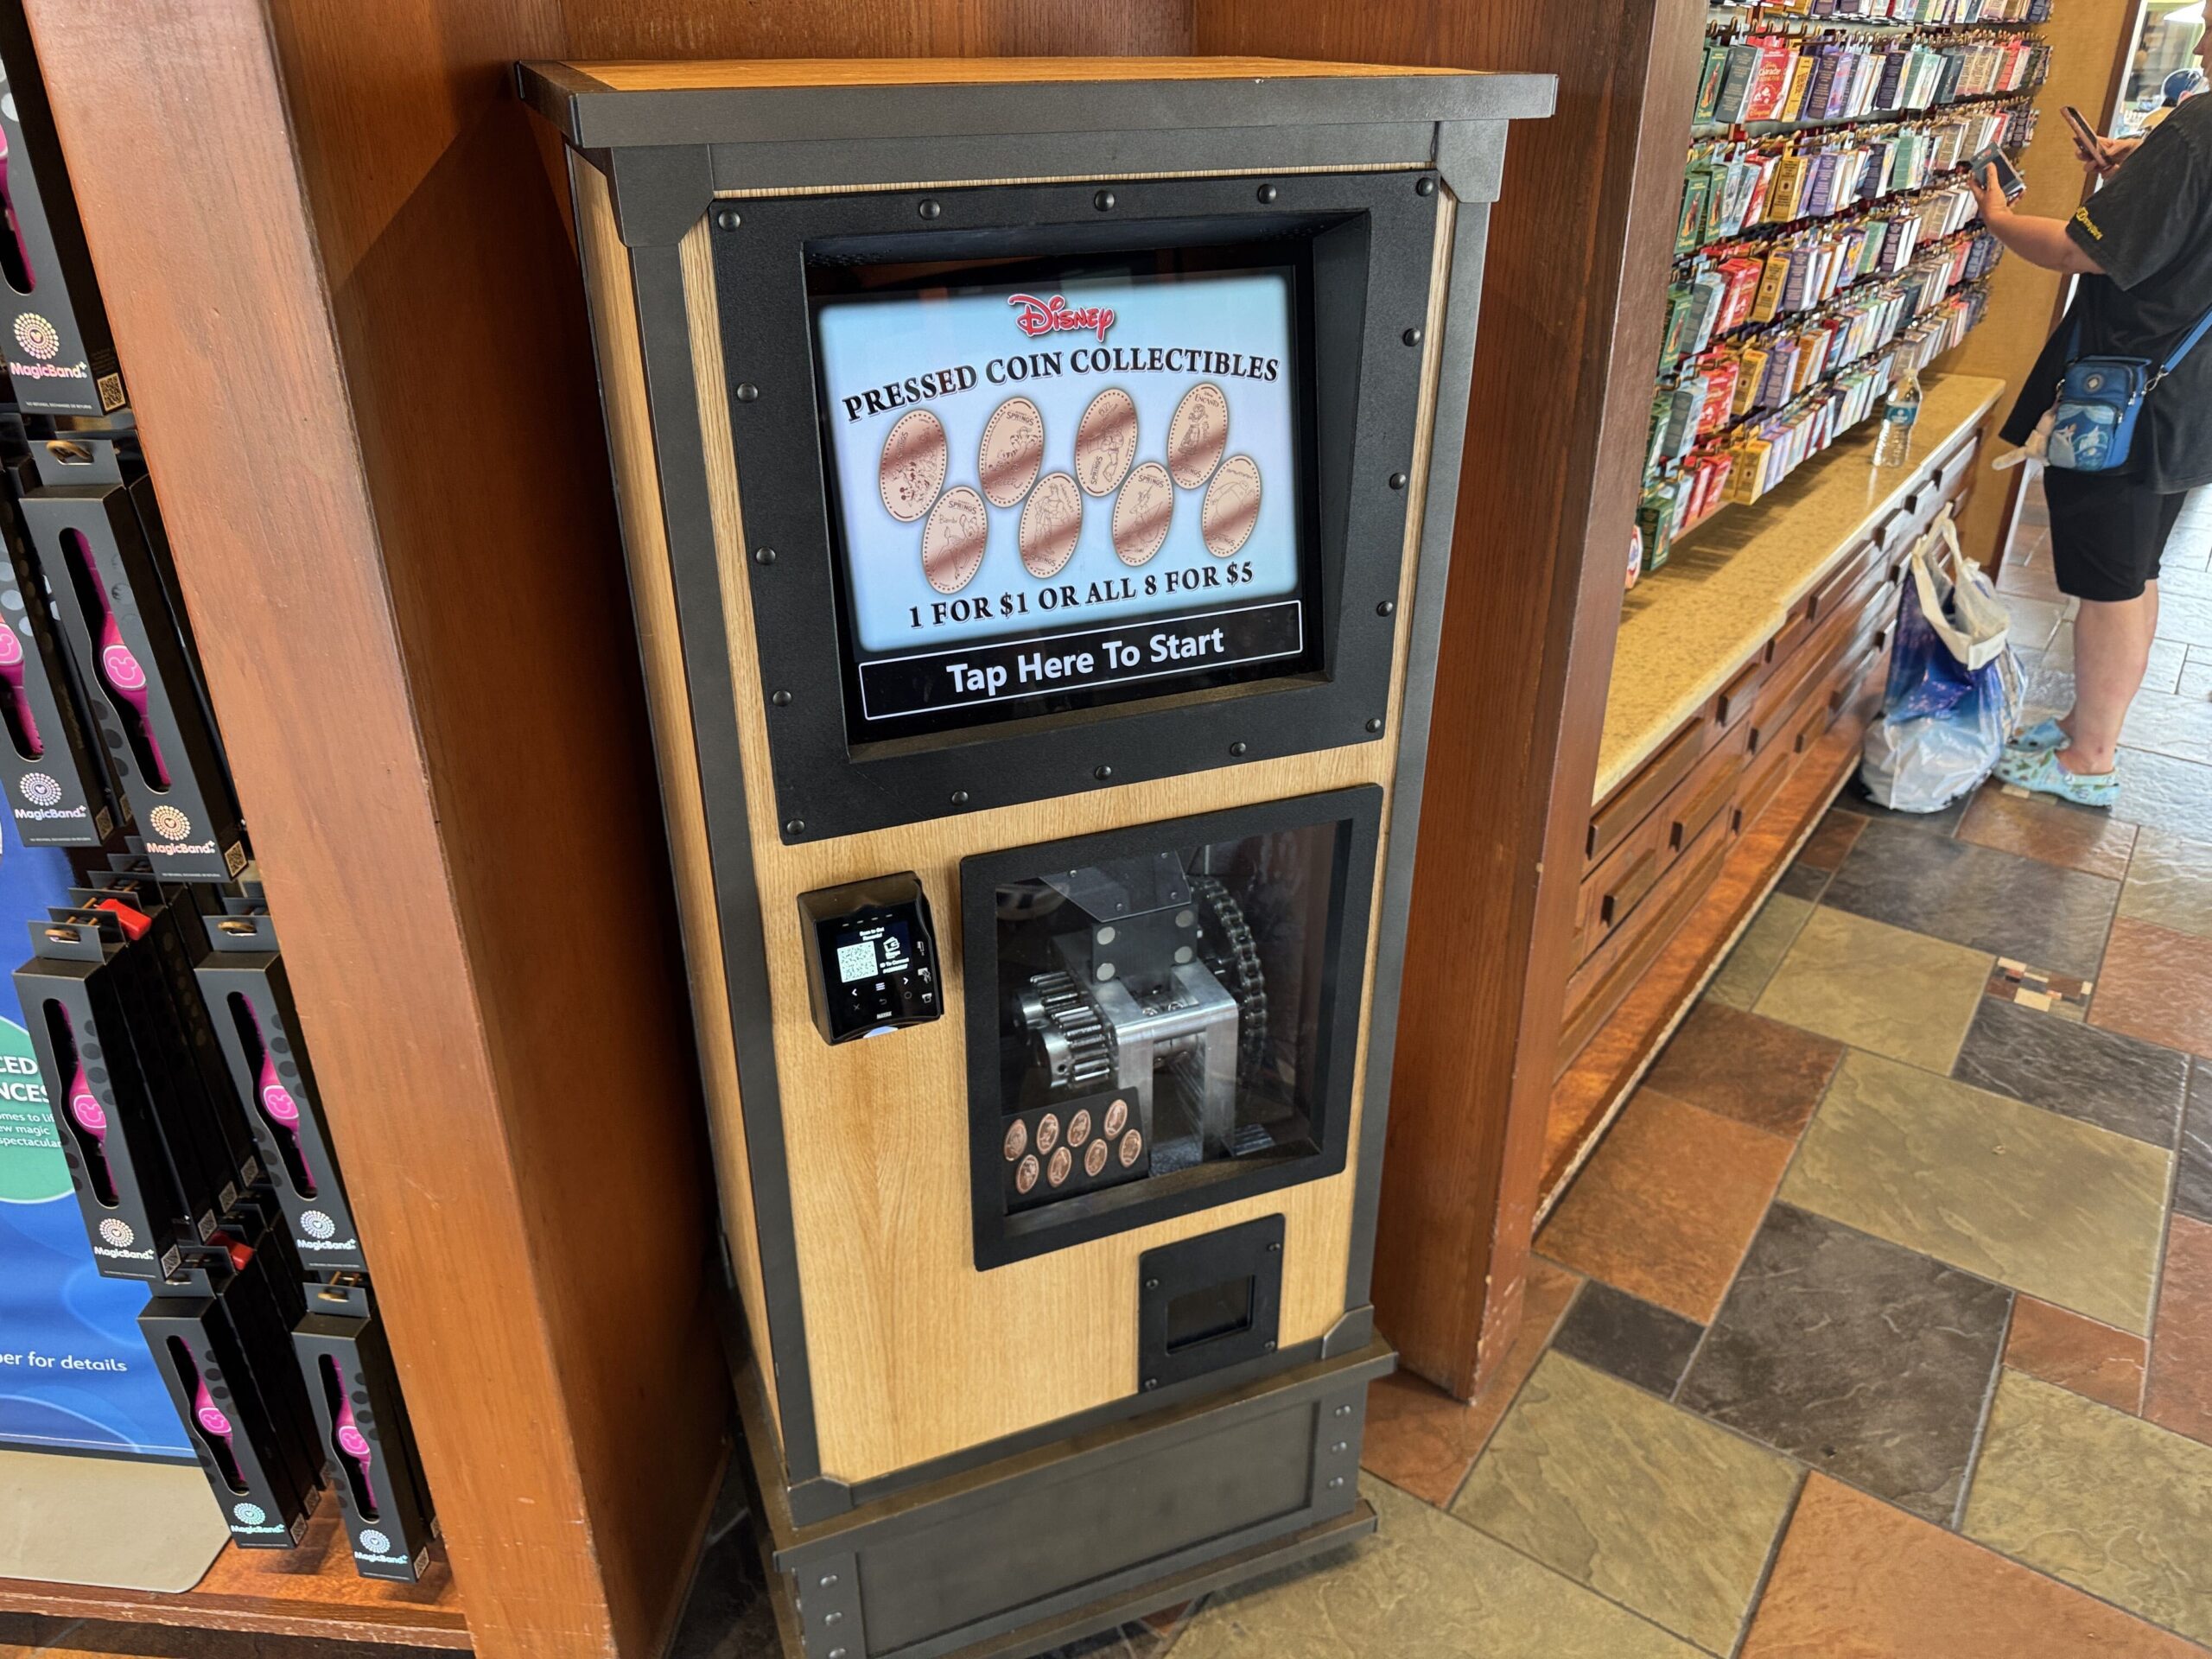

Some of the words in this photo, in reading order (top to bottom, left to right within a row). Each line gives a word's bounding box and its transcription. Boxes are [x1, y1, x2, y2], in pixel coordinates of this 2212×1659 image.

[1007, 294, 1116, 342] Disney
[842, 364, 978, 423] PRESSED
[985, 351, 1065, 385] COIN
[1070, 347, 1281, 383] COLLECTIBLES
[1006, 411, 1034, 426] SPRINGS
[1138, 474, 1164, 488] SPRINGS
[948, 499, 977, 516] SPRINGS
[909, 606, 924, 628] 1
[931, 596, 994, 626] FOR
[1000, 592, 1030, 619] $1
[1039, 585, 1080, 611] OR
[1084, 577, 1137, 605] ALL
[1144, 574, 1158, 596] 8
[1165, 565, 1221, 594] FOR
[1226, 561, 1254, 587] $5
[946, 663, 1007, 696] Tap
[1017, 652, 1095, 683] Here
[1102, 640, 1141, 670] To
[1149, 627, 1224, 663] Start
[28, 1113, 41, 1122] to
[16, 1126, 50, 1137] magic
[28, 1351, 55, 1368] for
[60, 1355, 128, 1372] details
